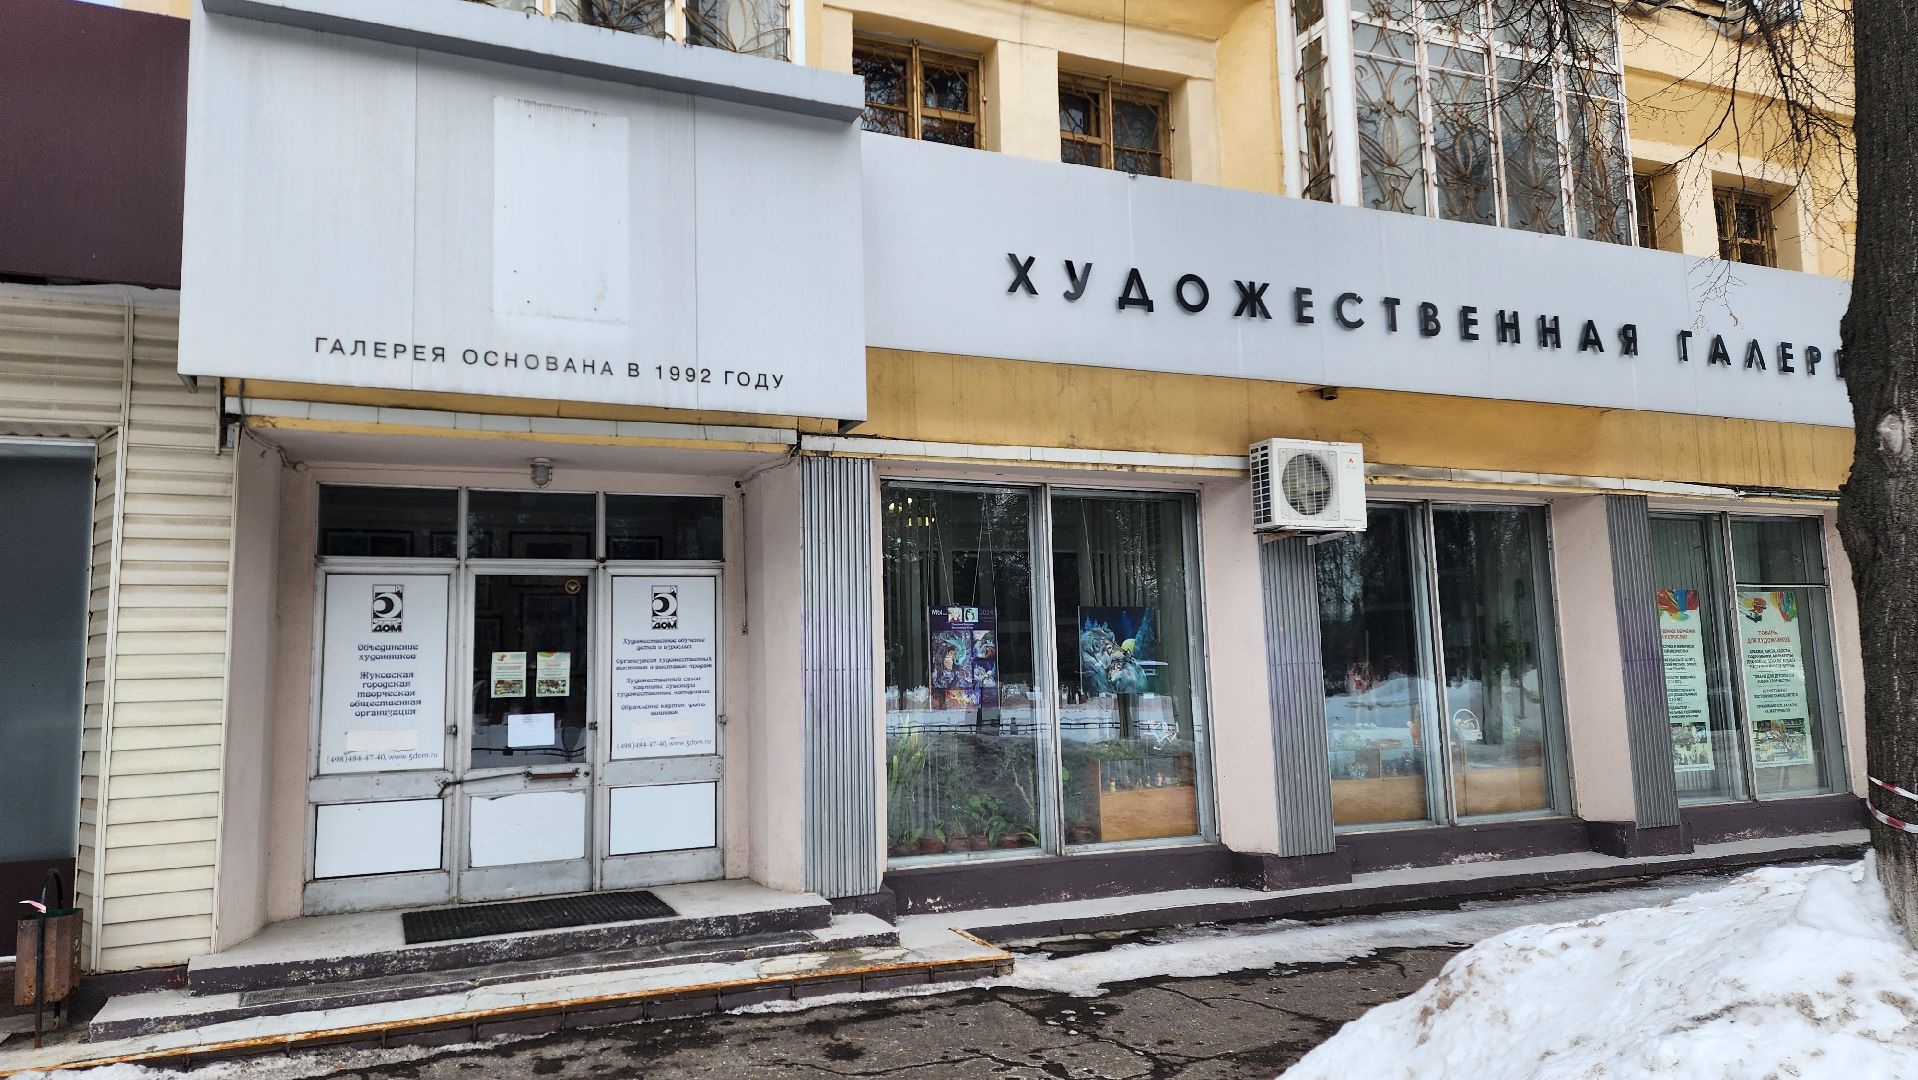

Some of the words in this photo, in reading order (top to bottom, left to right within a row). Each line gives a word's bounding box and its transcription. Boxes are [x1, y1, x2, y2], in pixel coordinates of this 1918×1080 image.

[1007, 252, 1639, 357] ХУДОЖЕСТВЕННАЯ
[315, 337, 445, 363] ГАЛЕРЕЯ
[462, 348, 614, 376] ОСНОВАНА
[627, 362, 640, 378] В
[655, 364, 711, 384] 1992
[724, 370, 784, 391] ГОДУ
[371, 624, 402, 633] ДОМ
[652, 621, 677, 629] ДОМ
[357, 643, 419, 653] Объединение
[359, 653, 417, 661] художников
[359, 671, 414, 680] Жуковская
[362, 681, 411, 689] городская
[357, 690, 415, 698] творческая
[349, 699, 422, 708] общественная
[354, 709, 416, 718] организация
